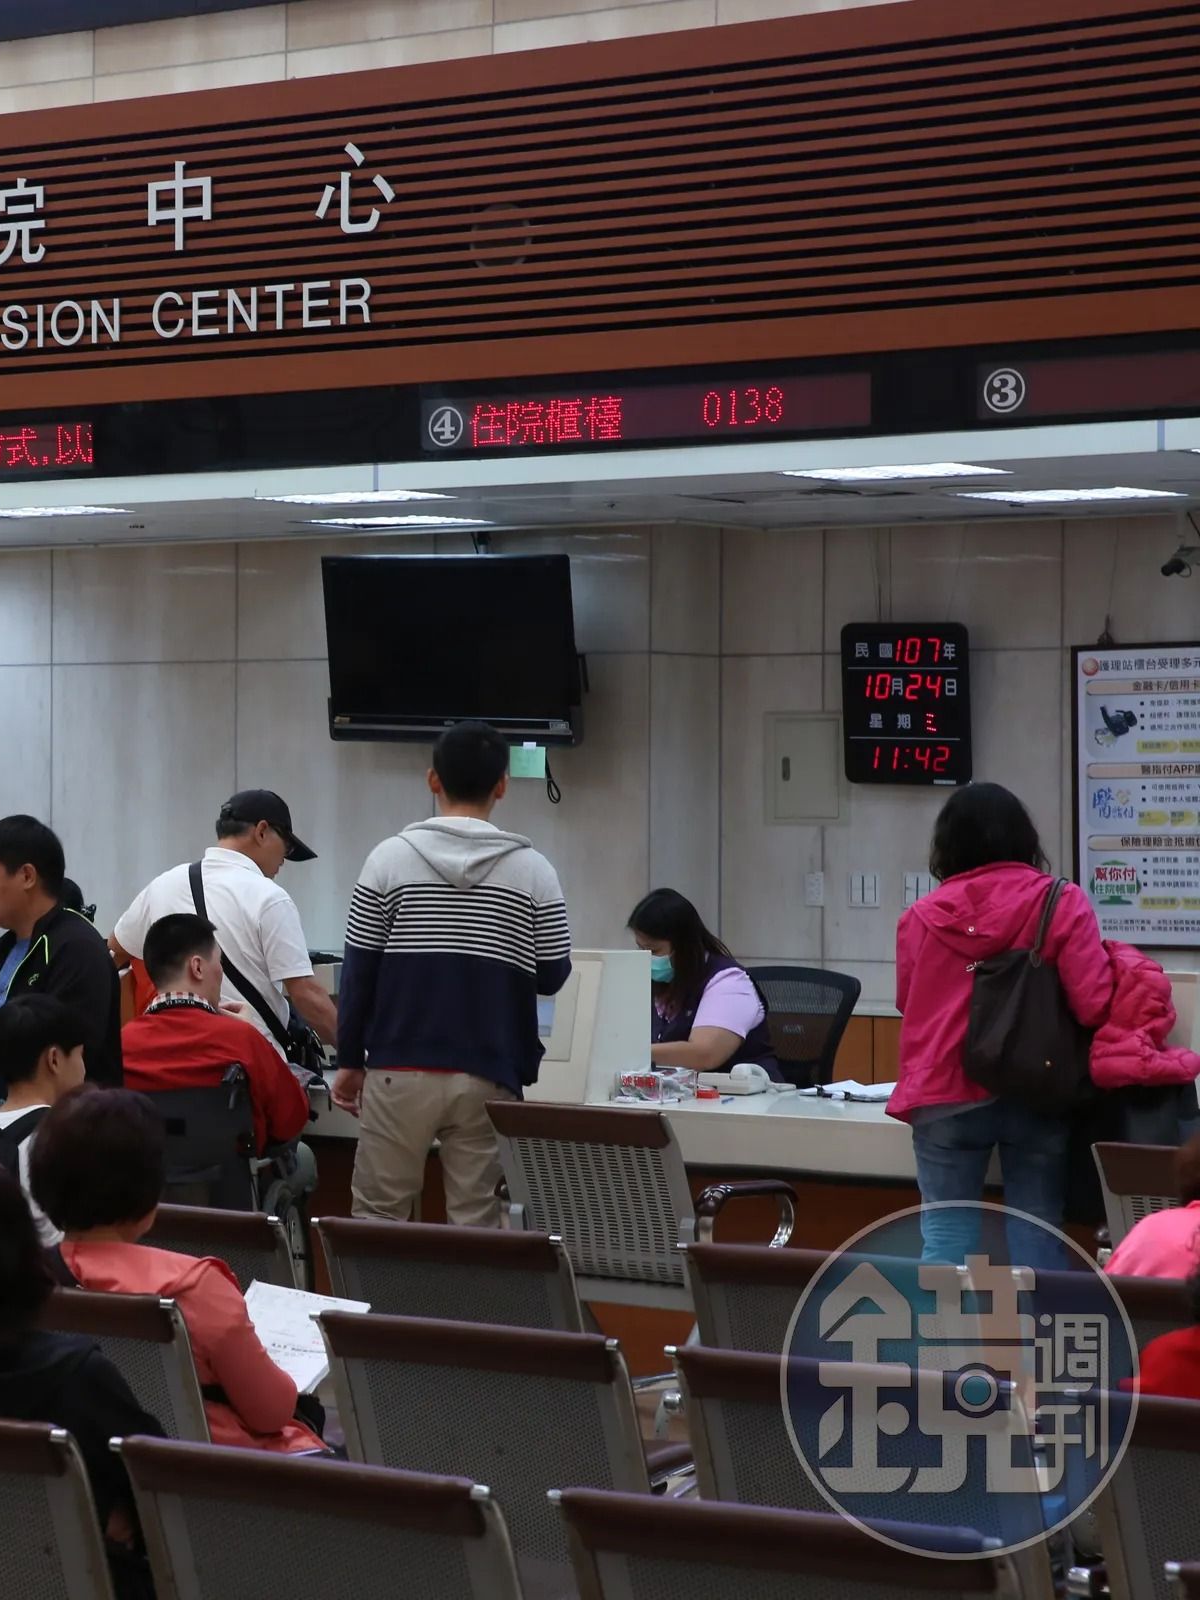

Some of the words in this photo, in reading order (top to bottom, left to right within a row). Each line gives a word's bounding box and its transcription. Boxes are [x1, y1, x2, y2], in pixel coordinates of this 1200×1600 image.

[151, 277, 372, 339] CENTER
[469, 396, 623, 447] 住院櫃檯
[702, 387, 785, 427] 0138
[872, 746, 950, 772] 11:42
